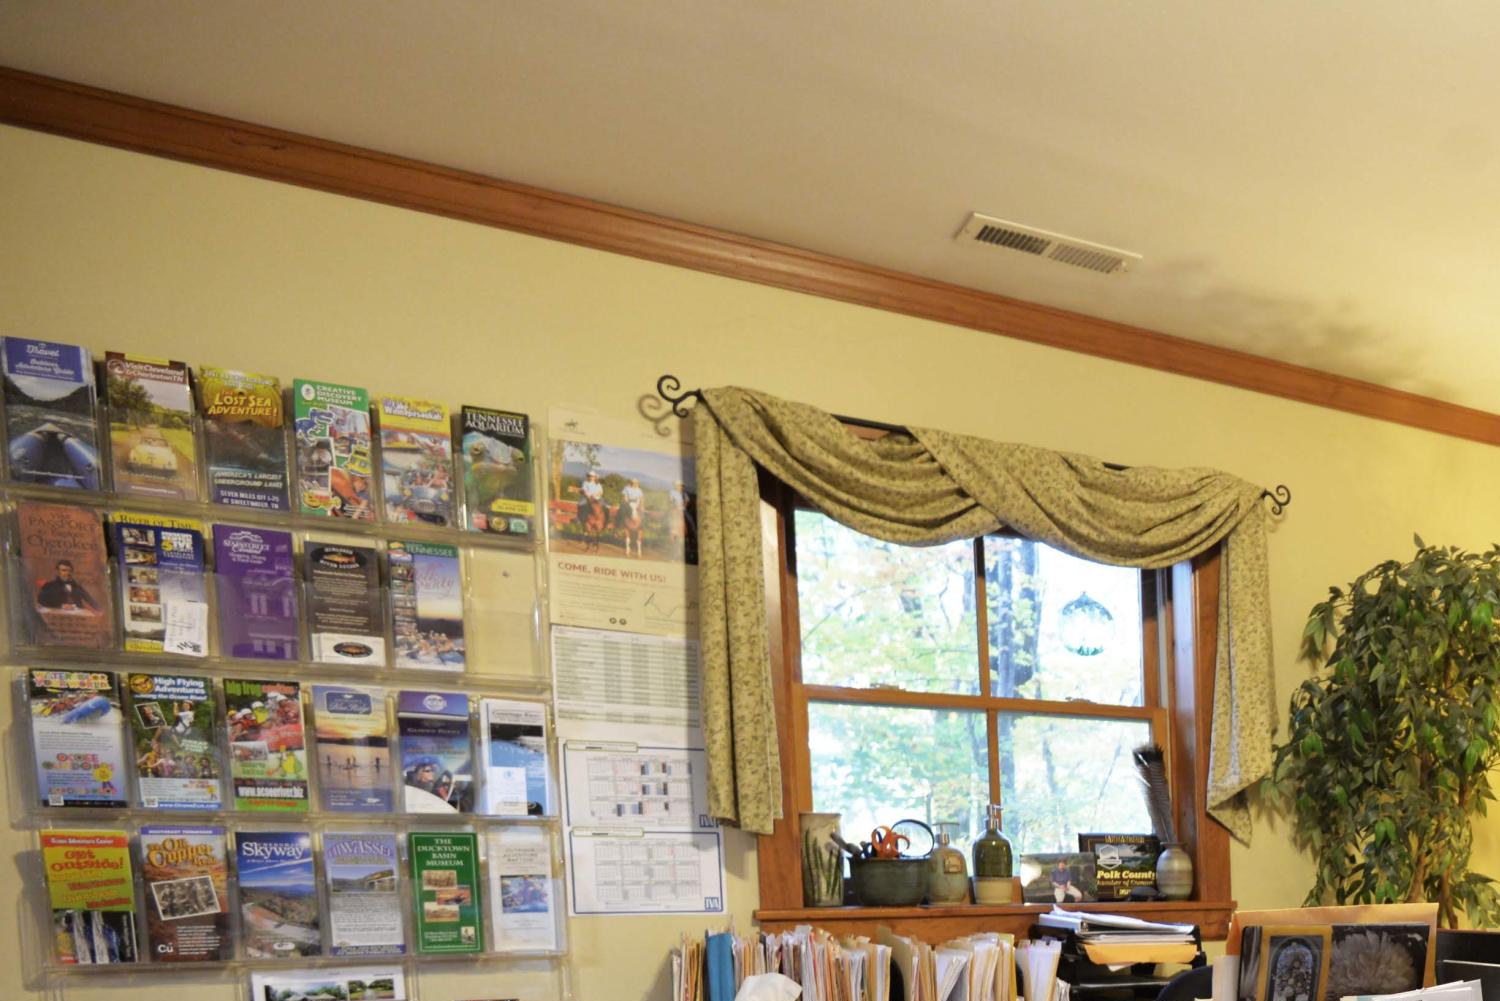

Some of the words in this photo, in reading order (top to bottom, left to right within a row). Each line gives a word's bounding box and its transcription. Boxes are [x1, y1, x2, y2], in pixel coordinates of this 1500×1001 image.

[316, 390, 361, 402] DISCOVERY
[317, 385, 356, 396] CREATIVE
[214, 393, 246, 406] LOST
[248, 395, 271, 407] SEA
[208, 405, 277, 416] ADVENTURE!
[465, 412, 523, 427] TENNESSEE
[465, 420, 525, 435] AQUARIUM
[594, 566, 617, 577] RIDE
[621, 569, 648, 581] WITH
[242, 841, 305, 860] Skyway
[1097, 870, 1120, 879] Polk
